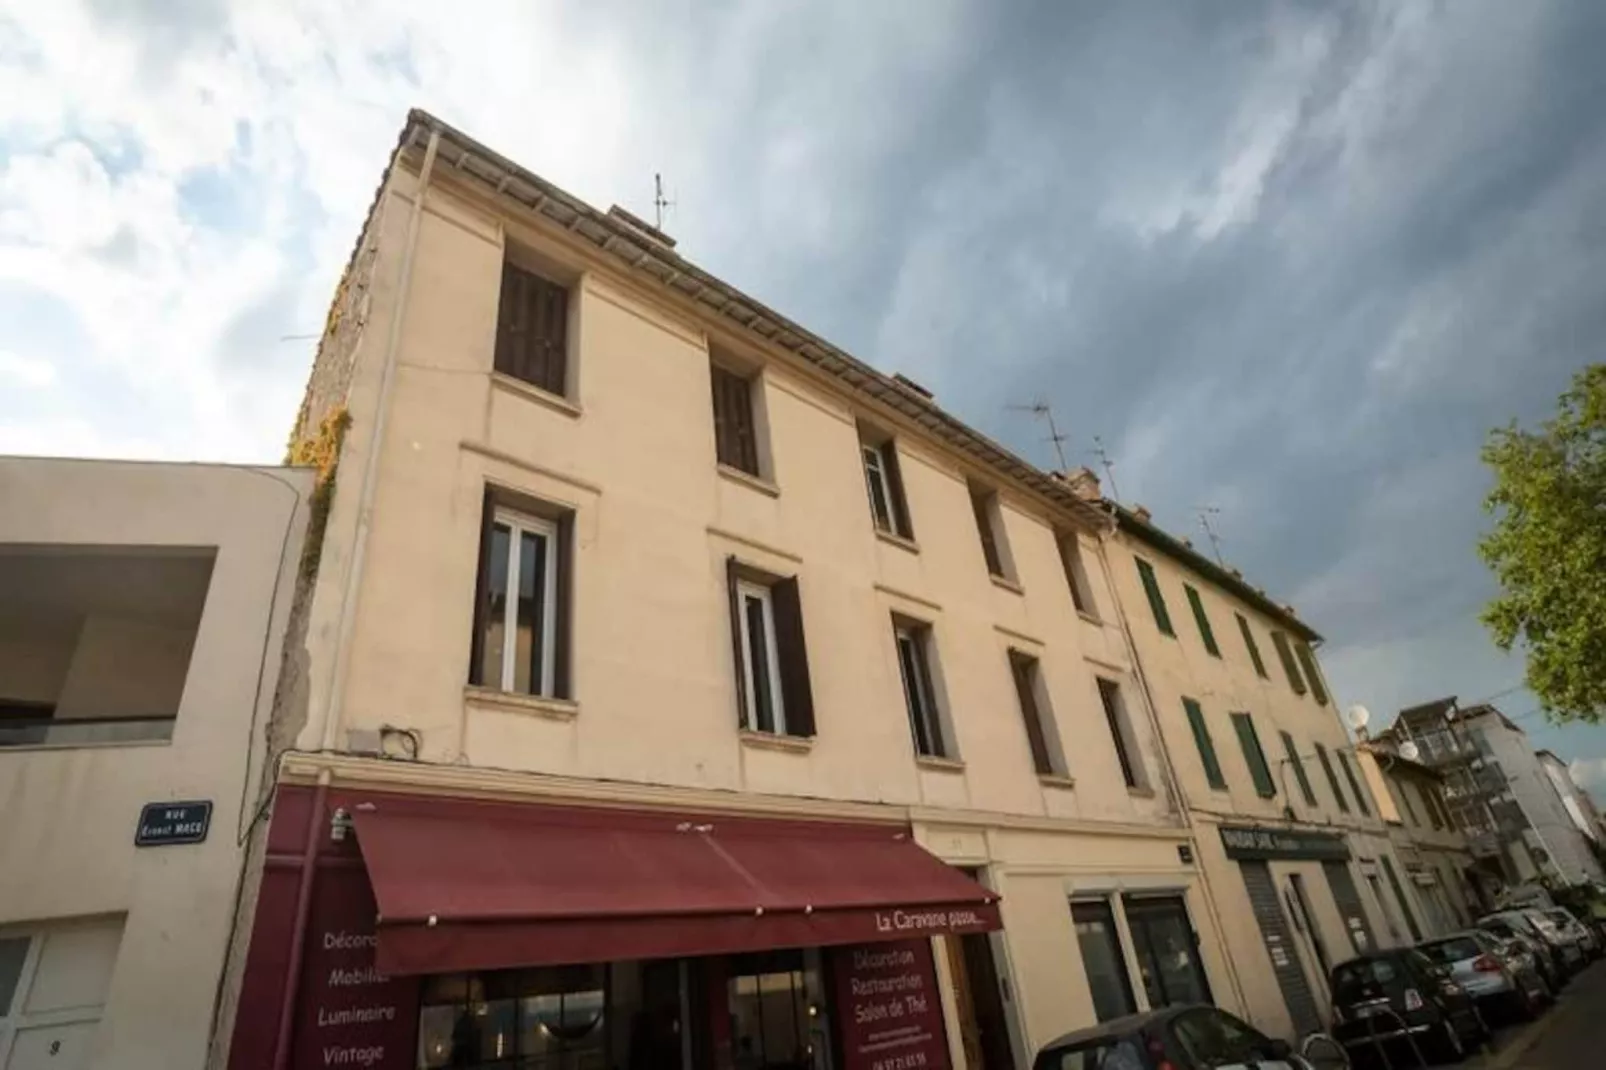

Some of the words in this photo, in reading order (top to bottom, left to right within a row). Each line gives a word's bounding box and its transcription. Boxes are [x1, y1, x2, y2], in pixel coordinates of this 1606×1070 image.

[165, 809, 186, 820] RUE
[876, 913, 893, 931] La
[893, 910, 947, 929] Caravane
[854, 950, 915, 969] Décoration
[851, 974, 922, 995] Restauration
[318, 1004, 396, 1027] Luminaire
[855, 1002, 888, 1024] Salon
[889, 997, 904, 1018] de
[905, 992, 928, 1015] Thé
[322, 1046, 385, 1067] Vintage
